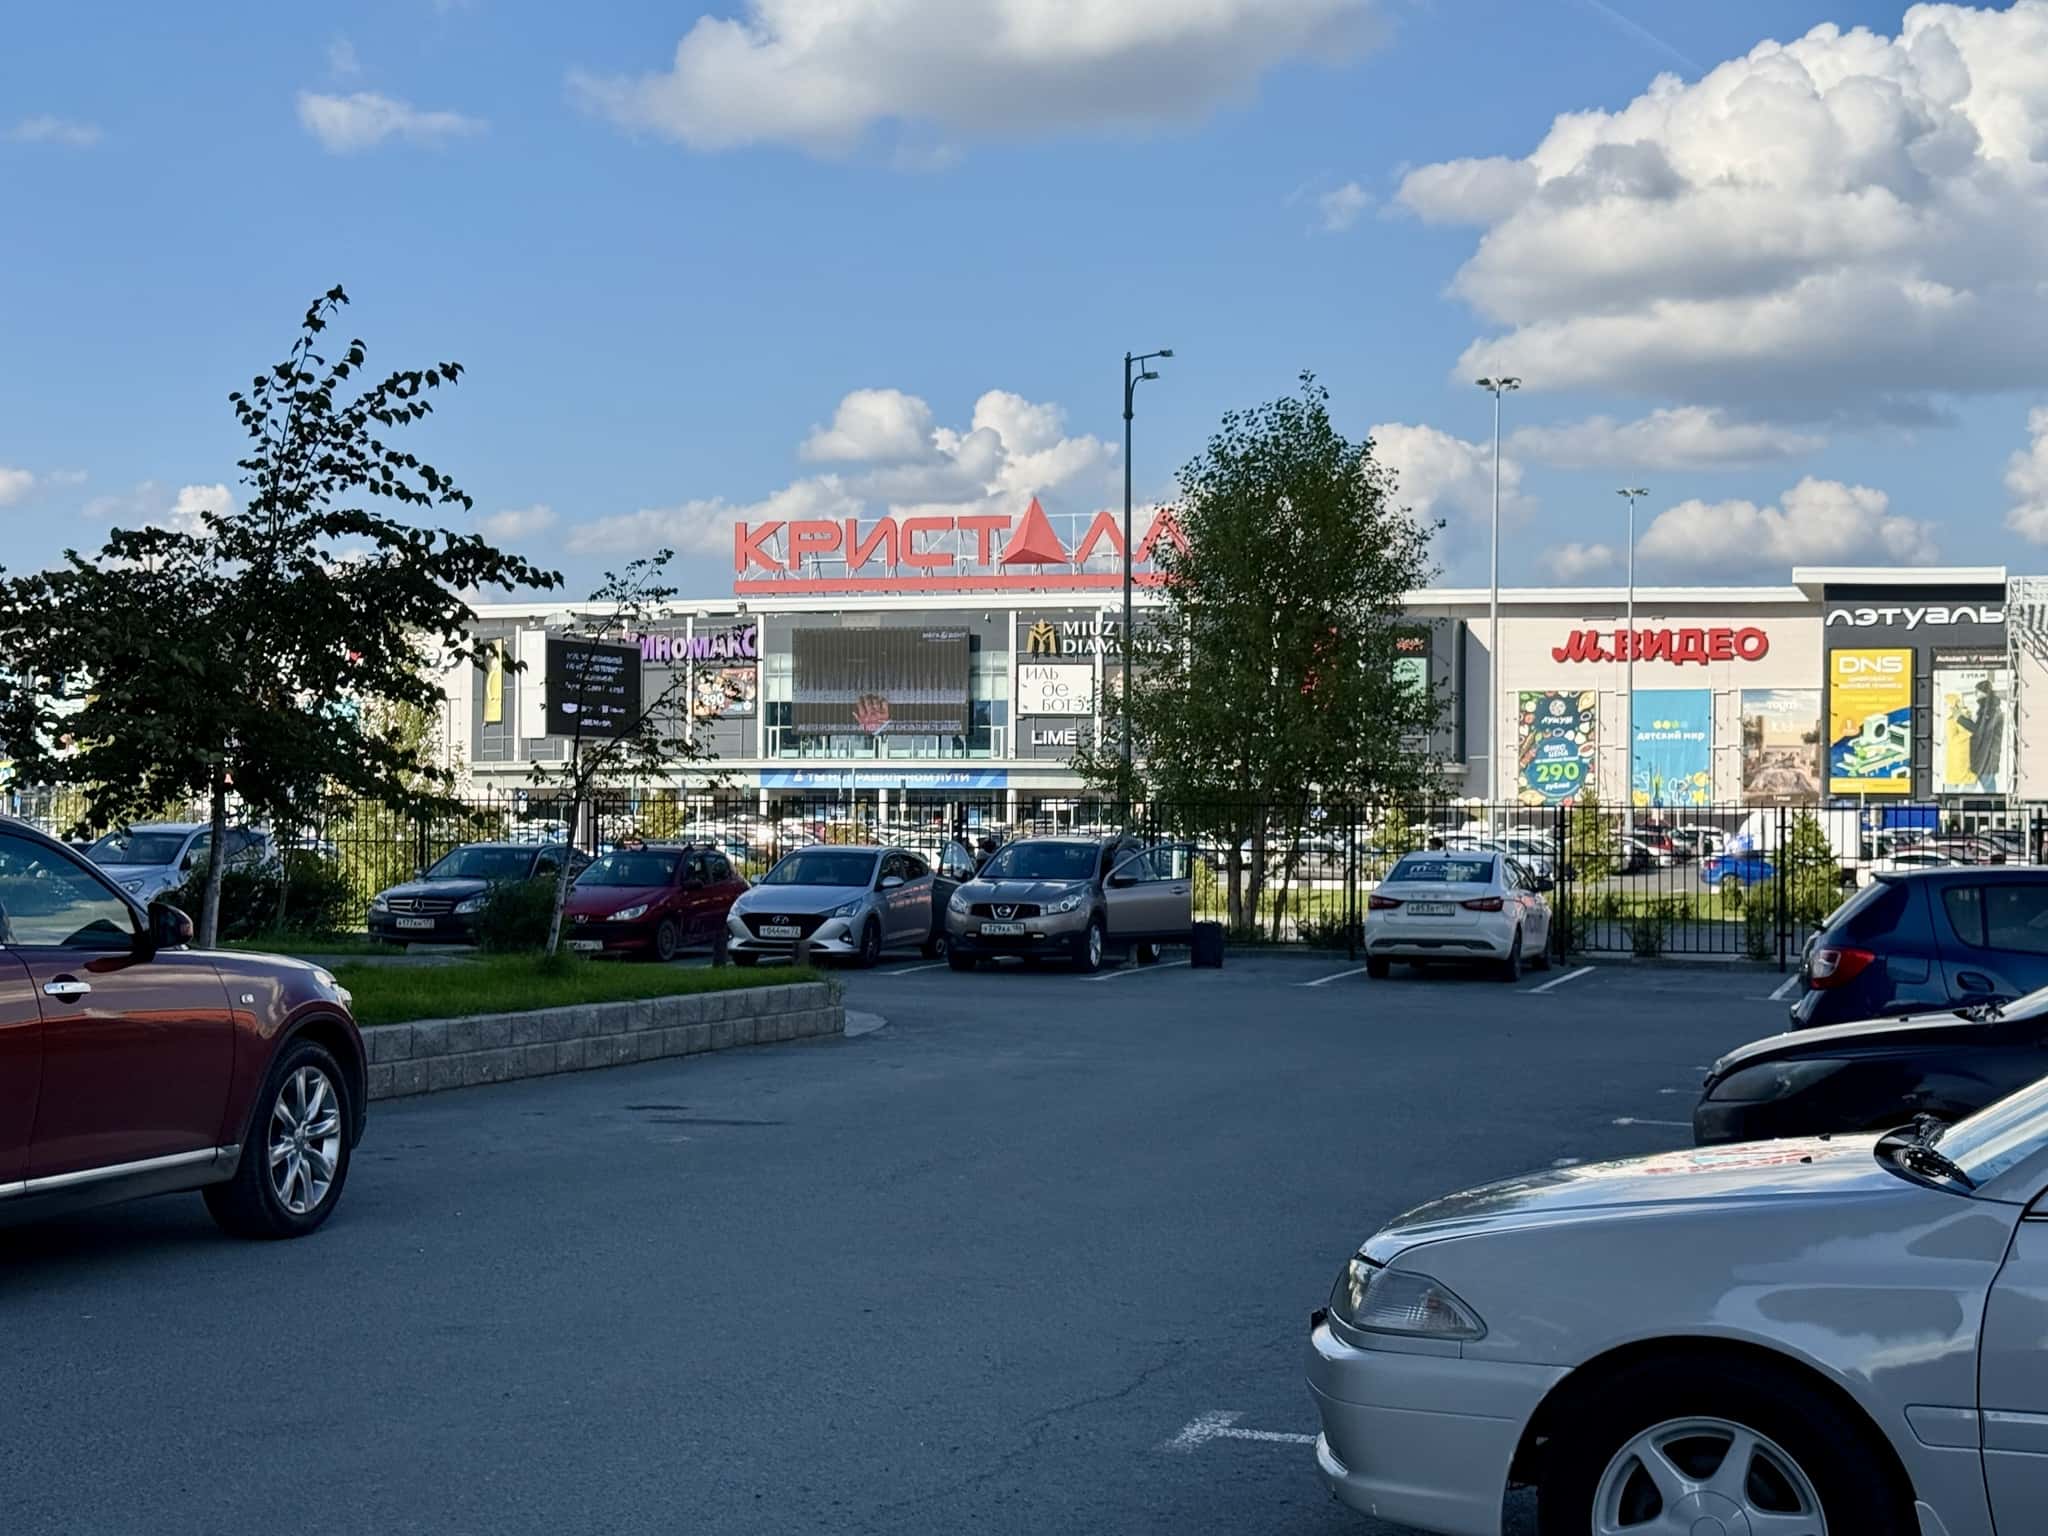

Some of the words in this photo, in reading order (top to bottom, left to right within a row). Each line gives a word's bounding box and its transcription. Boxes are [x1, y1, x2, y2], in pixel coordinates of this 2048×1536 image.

[1063, 621, 1115, 636] MIUZ
[1063, 639, 1172, 653] DIAMNDS
[1552, 627, 1769, 665] М.ВИДЕО
[1839, 656, 1903, 673] DNS
[1026, 667, 1058, 680] ИЛЬ
[1031, 730, 1077, 744] LIME
[1637, 730, 1681, 741] детский
[1684, 733, 1705, 742] мир
[1536, 762, 1580, 782] 290
